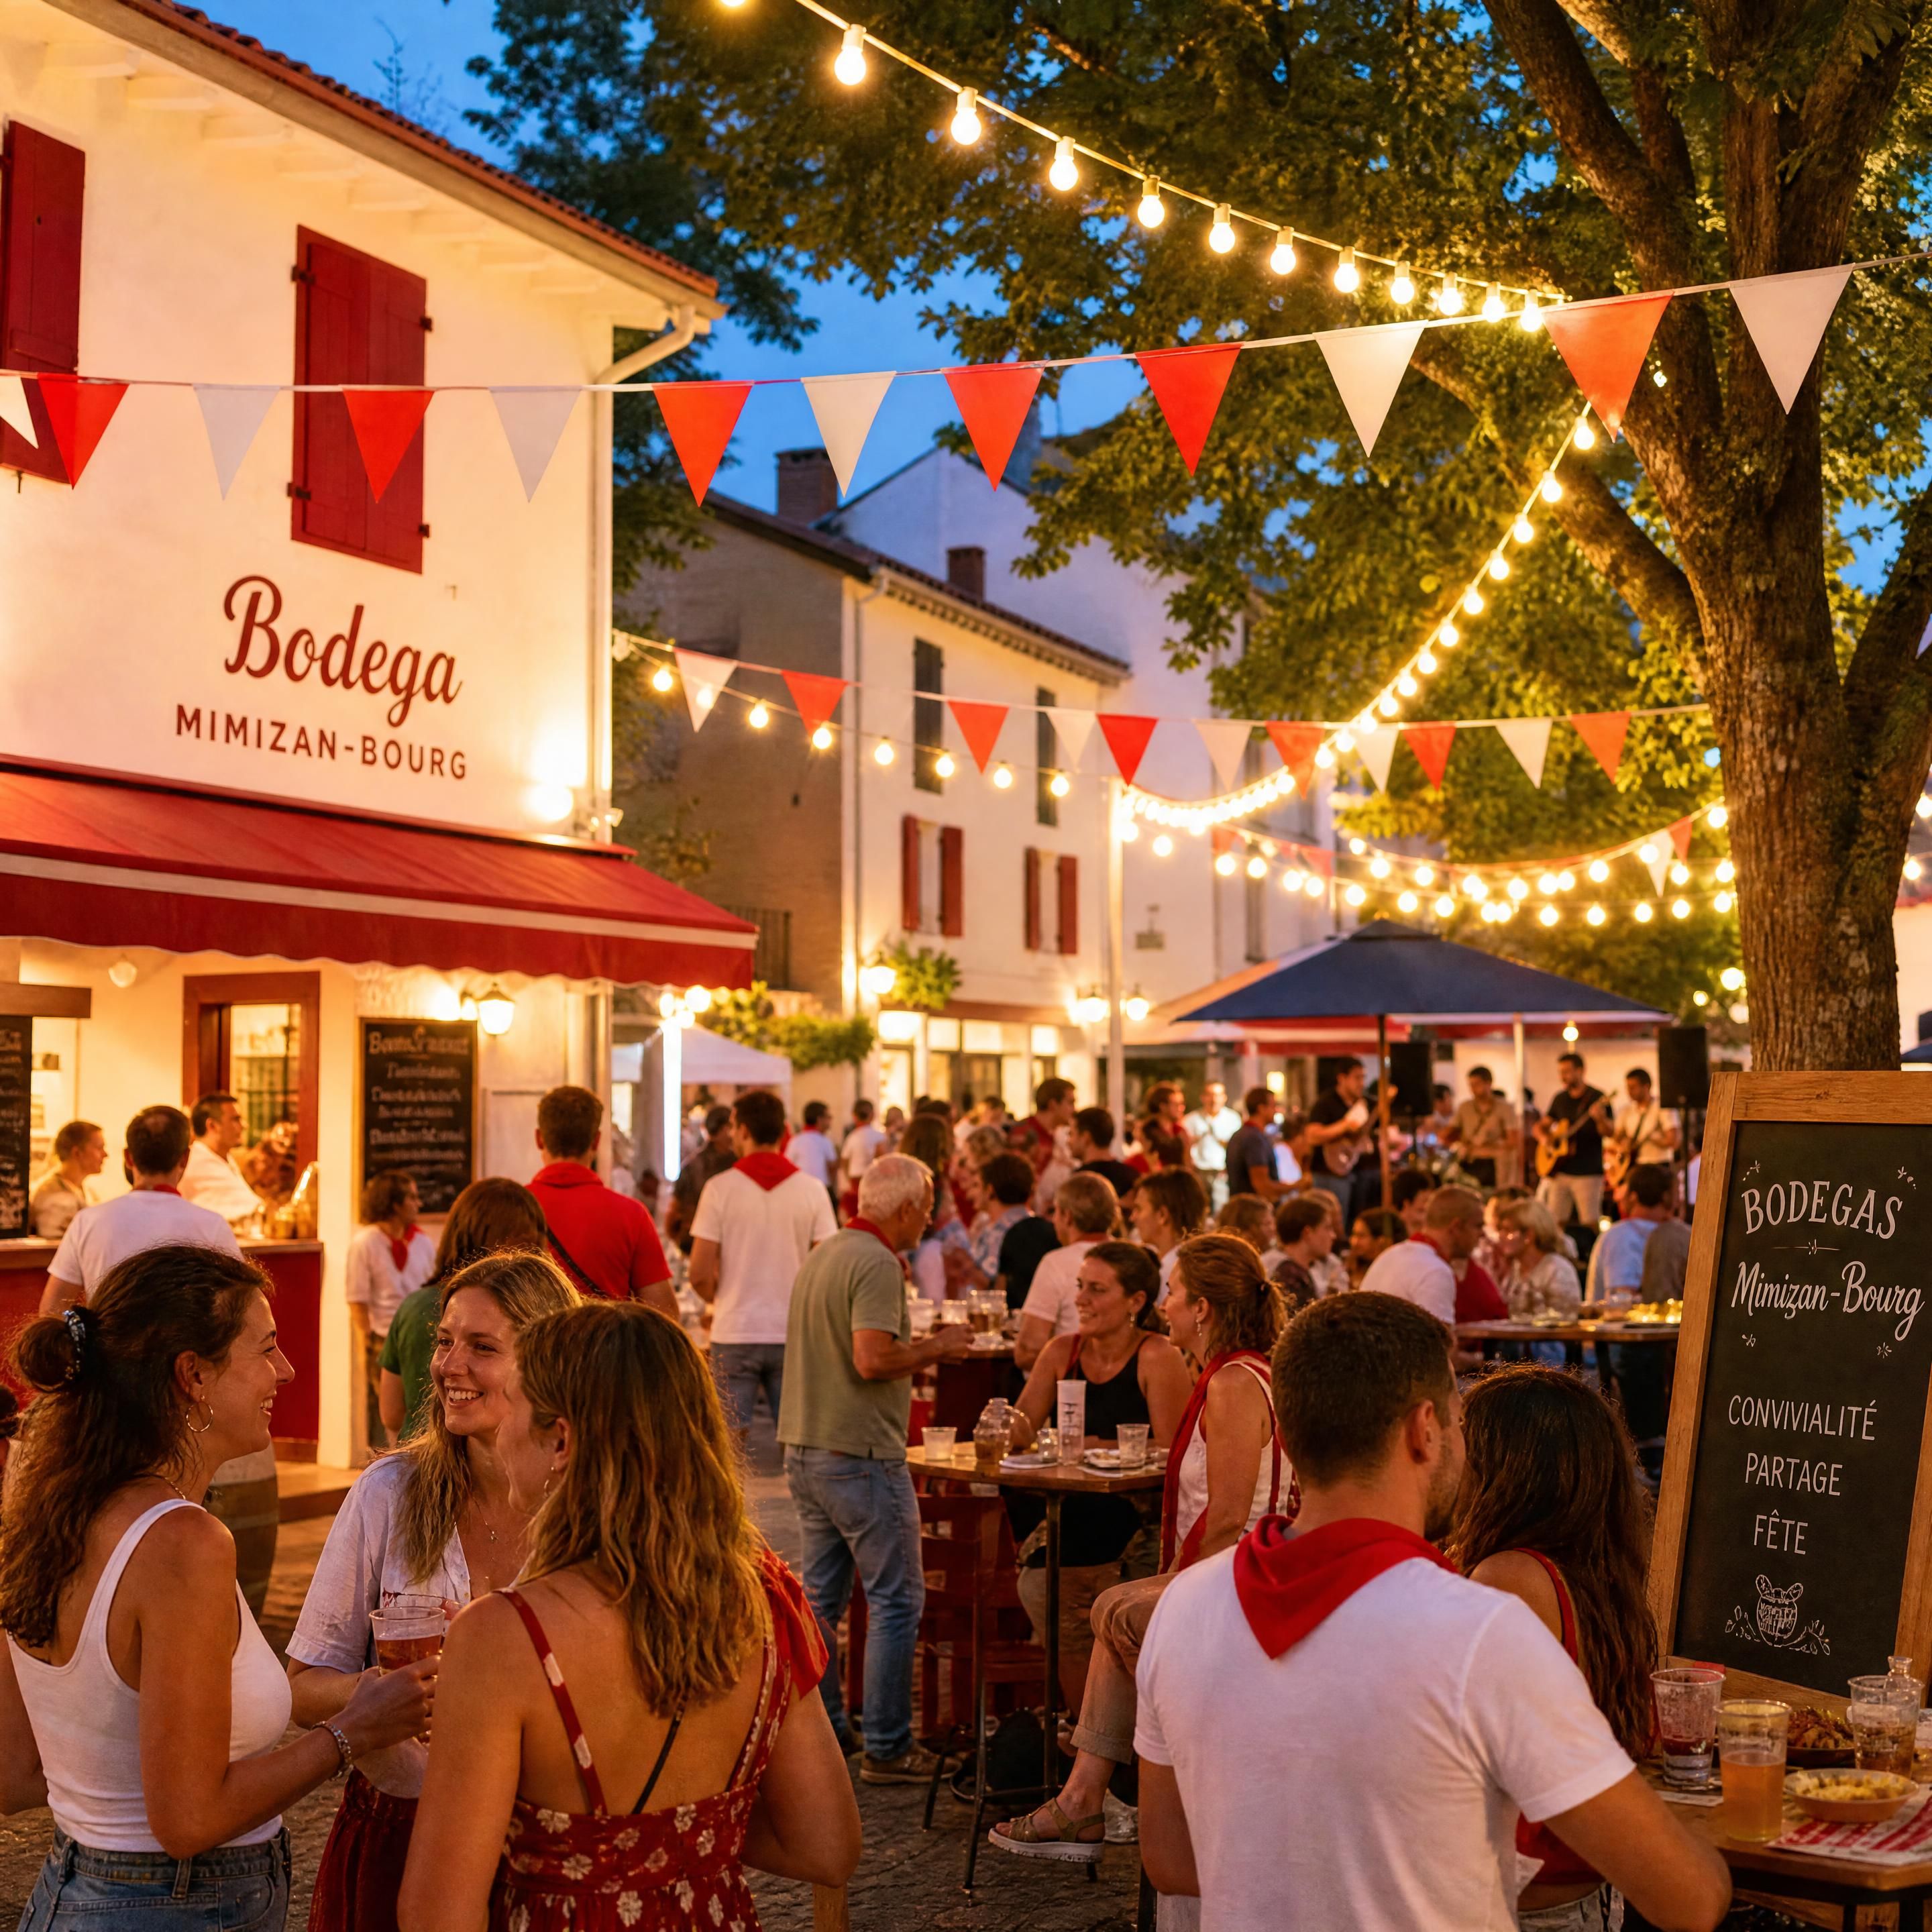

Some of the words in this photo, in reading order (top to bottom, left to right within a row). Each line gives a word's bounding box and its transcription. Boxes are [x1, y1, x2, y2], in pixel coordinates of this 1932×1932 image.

[223, 576, 463, 728] Bodega
[176, 704, 467, 780] MIMIZAN-BOURG
[1741, 1181, 1902, 1239] BODEGAS
[1731, 1260, 1925, 1341] Mimizan-Bourg
[1728, 1395, 1877, 1440] CONVIVIALITÉ
[1745, 1452, 1843, 1496] PARTAGE
[1754, 1509, 1809, 1555] FÊTE
